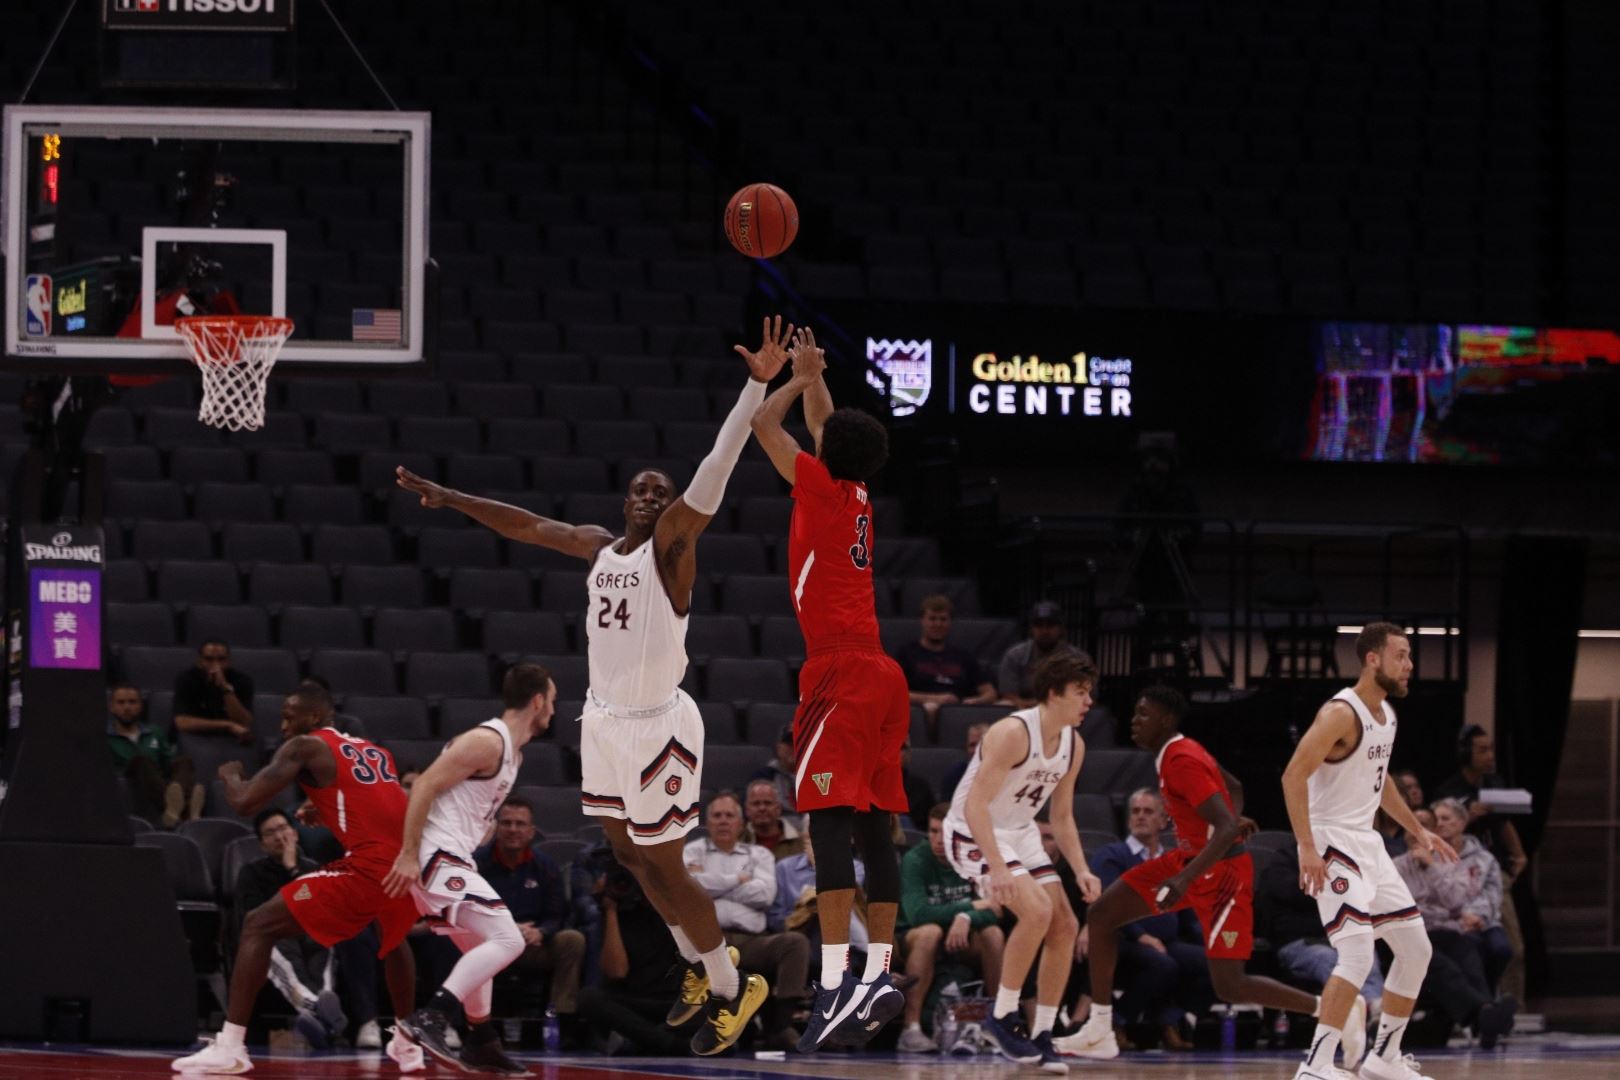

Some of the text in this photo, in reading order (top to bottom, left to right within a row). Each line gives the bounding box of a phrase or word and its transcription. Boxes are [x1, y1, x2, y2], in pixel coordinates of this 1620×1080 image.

[968, 384, 1132, 416] CENTER
[26, 541, 101, 564] SPALDING
[849, 514, 870, 570] 3
[39, 580, 92, 604] MEBO
[597, 596, 633, 630] 24
[339, 742, 400, 784] 32
[812, 772, 833, 795] V
[1374, 765, 1384, 793] 3
[1014, 783, 1044, 808] 44
